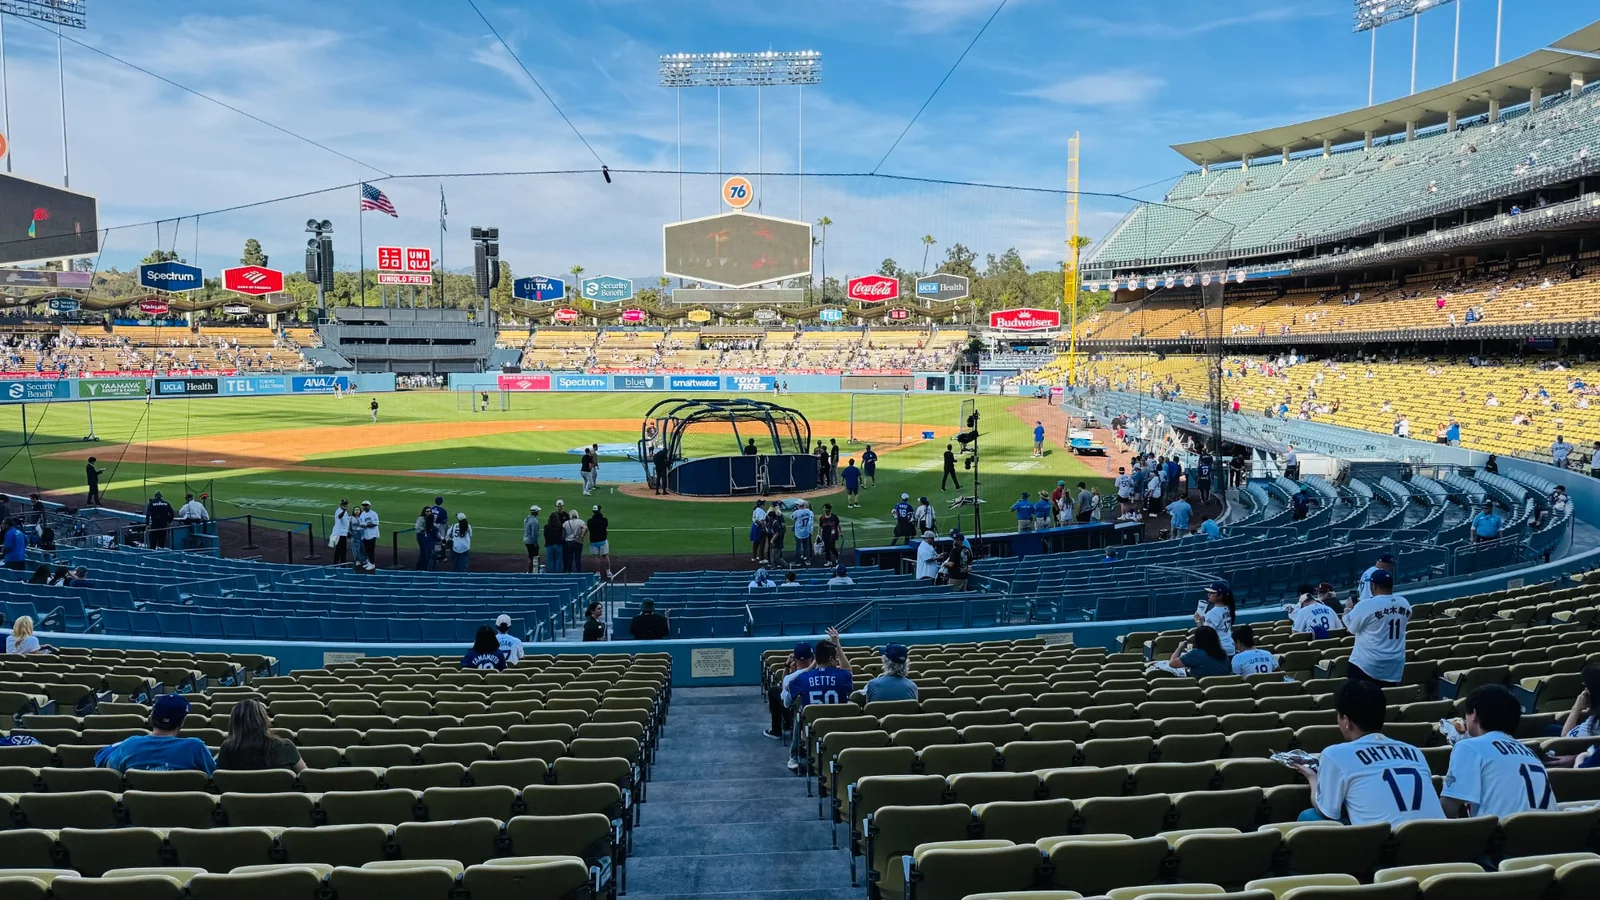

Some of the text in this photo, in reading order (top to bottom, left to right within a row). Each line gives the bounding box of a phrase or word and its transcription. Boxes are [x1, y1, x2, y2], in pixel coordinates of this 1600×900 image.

[730, 185, 747, 199] 76
[409, 251, 426, 259] UNI
[410, 260, 428, 269] QLO
[147, 270, 194, 282] Spectrum
[381, 275, 407, 283] UNIQLO
[523, 283, 554, 291] ULTRA
[600, 282, 628, 291] Security
[852, 281, 893, 296] Coca-Cola
[940, 283, 964, 292] Health
[601, 289, 624, 297] Benefit
[996, 317, 1052, 327] Budweiser
[163, 382, 214, 391] UCLA Health
[226, 379, 255, 392] TEL
[303, 378, 326, 387] ANA
[559, 377, 601, 388] Spectrum
[625, 377, 645, 386] blue
[672, 378, 718, 388] smartwater
[737, 382, 769, 390] TIRES
[26, 383, 56, 391] Security
[27, 390, 53, 398] Benefit
[899, 508, 907, 518] 16
[1388, 618, 1400, 640] 11
[472, 653, 500, 666] YAMAMOTO
[808, 675, 837, 687] BETTS
[1355, 745, 1420, 766] OHTANI
[1381, 767, 1424, 812] 17
[1518, 763, 1552, 810] 17
